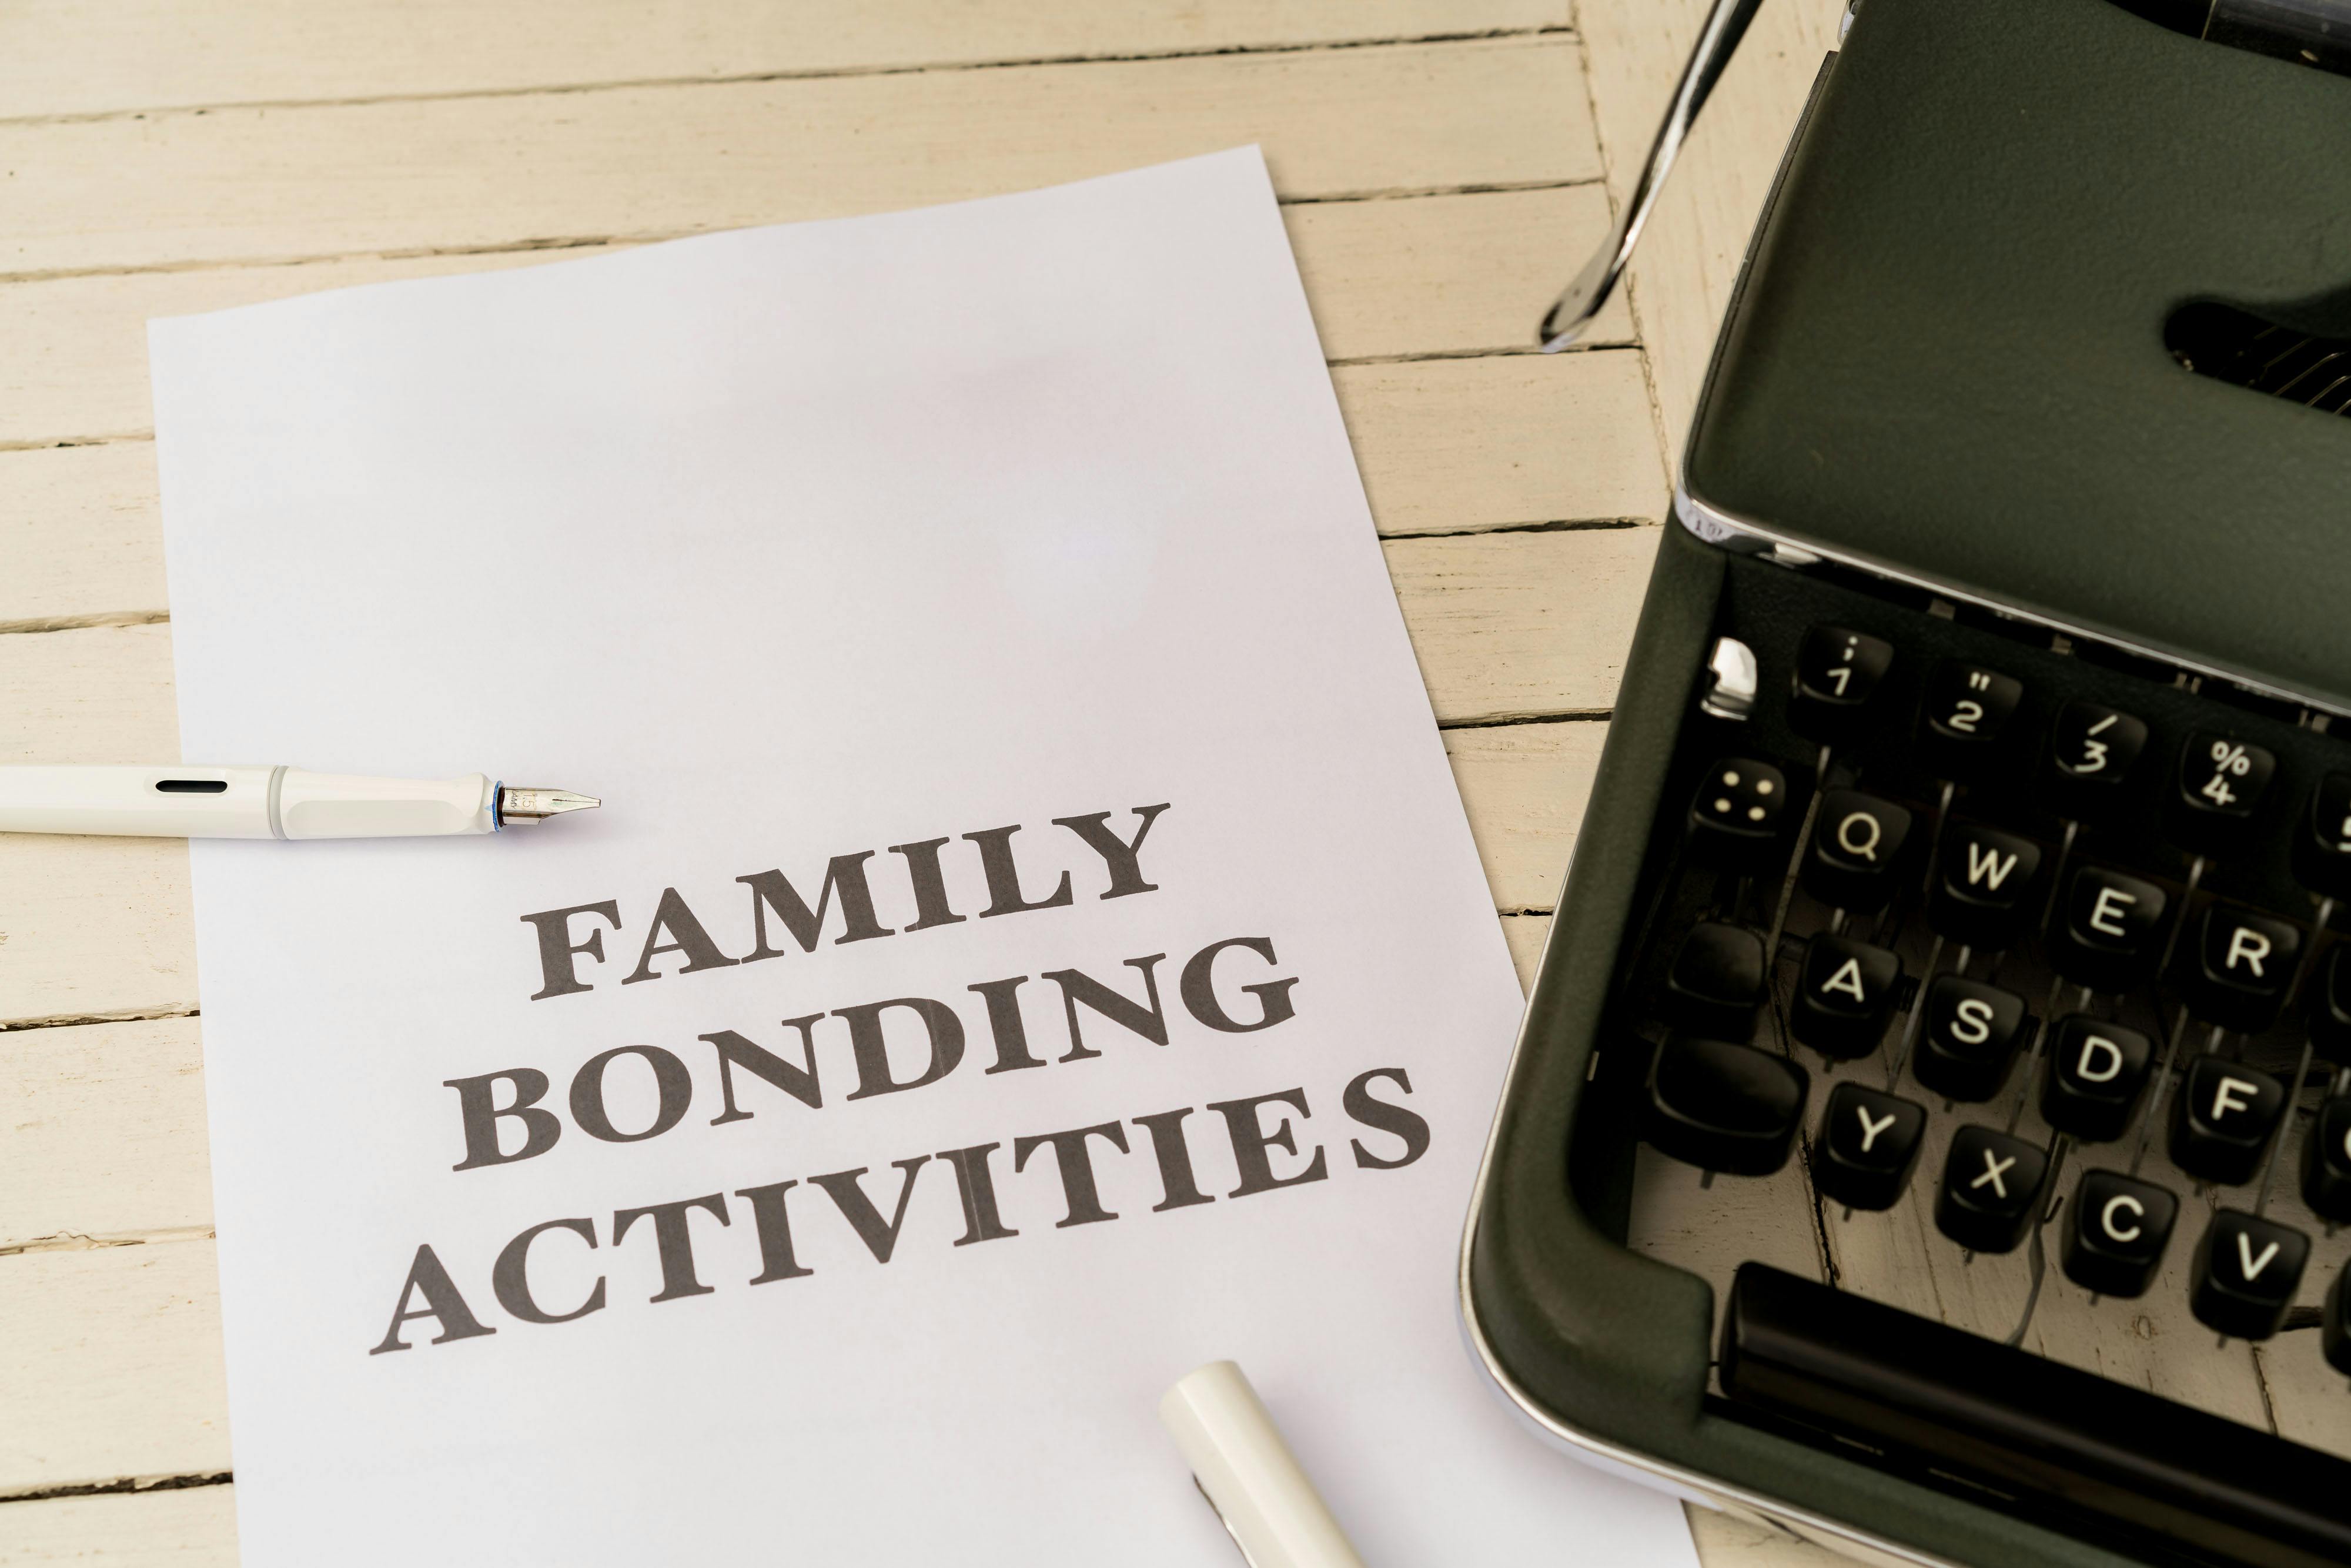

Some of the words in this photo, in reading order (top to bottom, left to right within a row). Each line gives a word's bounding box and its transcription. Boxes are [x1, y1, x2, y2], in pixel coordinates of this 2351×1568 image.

[1828, 668, 1851, 696] 1
[1949, 701, 1983, 731] 2
[2075, 740, 2107, 772] 3
[2203, 774, 2239, 805] 4
[1838, 812, 1881, 860] Q
[1969, 843, 2017, 890] W
[520, 803, 1171, 1001] FAMILY
[2091, 888, 2136, 935] E
[2227, 928, 2270, 976] R
[1822, 958, 1864, 1001] A
[1951, 999, 1994, 1044] S
[443, 937, 1299, 1172] BONDING
[2078, 1036, 2122, 1081] D
[2212, 1077, 2258, 1119] F
[1858, 1106, 1895, 1151] Y
[1972, 1149, 2015, 1197] X
[370, 1068, 1430, 1355] ACTIVITIES
[2102, 1195, 2144, 1241] C
[2238, 1233, 2279, 1280] V
